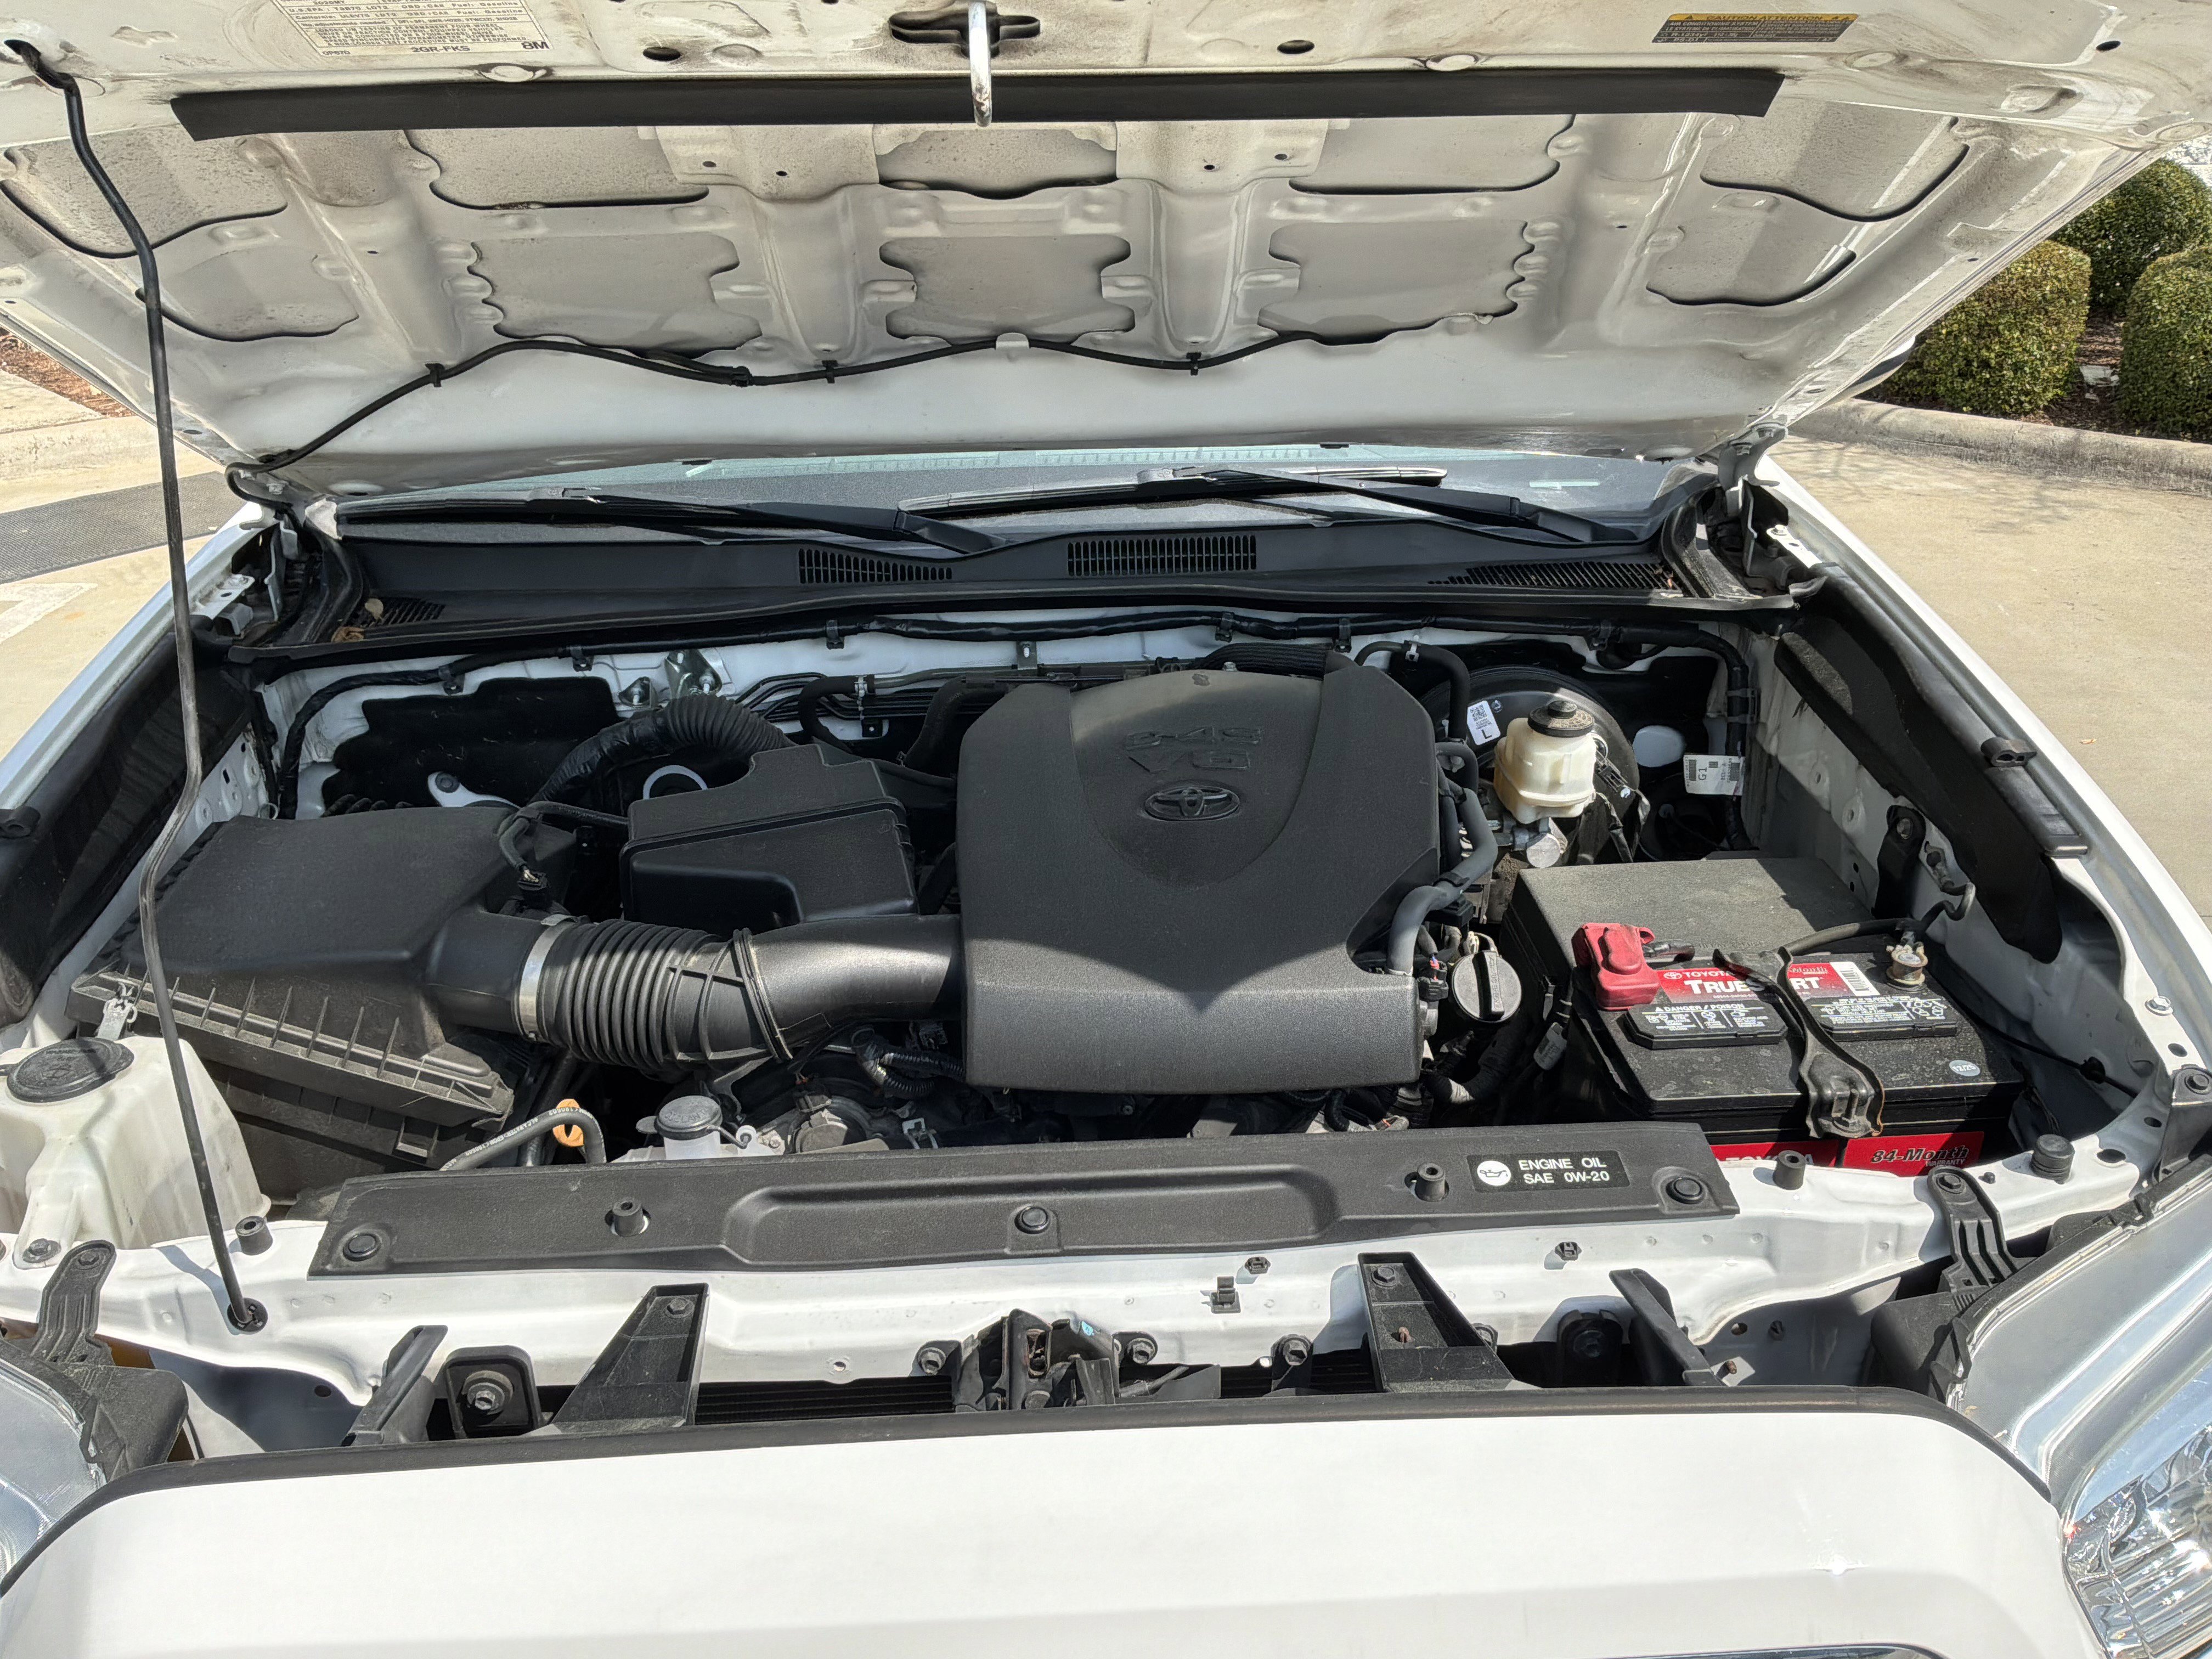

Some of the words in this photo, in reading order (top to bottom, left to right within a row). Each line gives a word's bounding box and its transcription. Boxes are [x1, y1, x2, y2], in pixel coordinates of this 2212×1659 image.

[521, 41, 550, 50] 8M
[1481, 729, 1493, 740] L
[1698, 768, 1707, 780] G1
[1684, 977, 1820, 994] TRUESRT
[1870, 1145, 1969, 1163] 84-Month
[1518, 1158, 1573, 1170] ENGINE
[1581, 1158, 1607, 1168] OIL
[1926, 1158, 1966, 1167] WARRANTY
[1523, 1173, 1555, 1184] SAE
[1564, 1171, 1610, 1182] 0W-20
